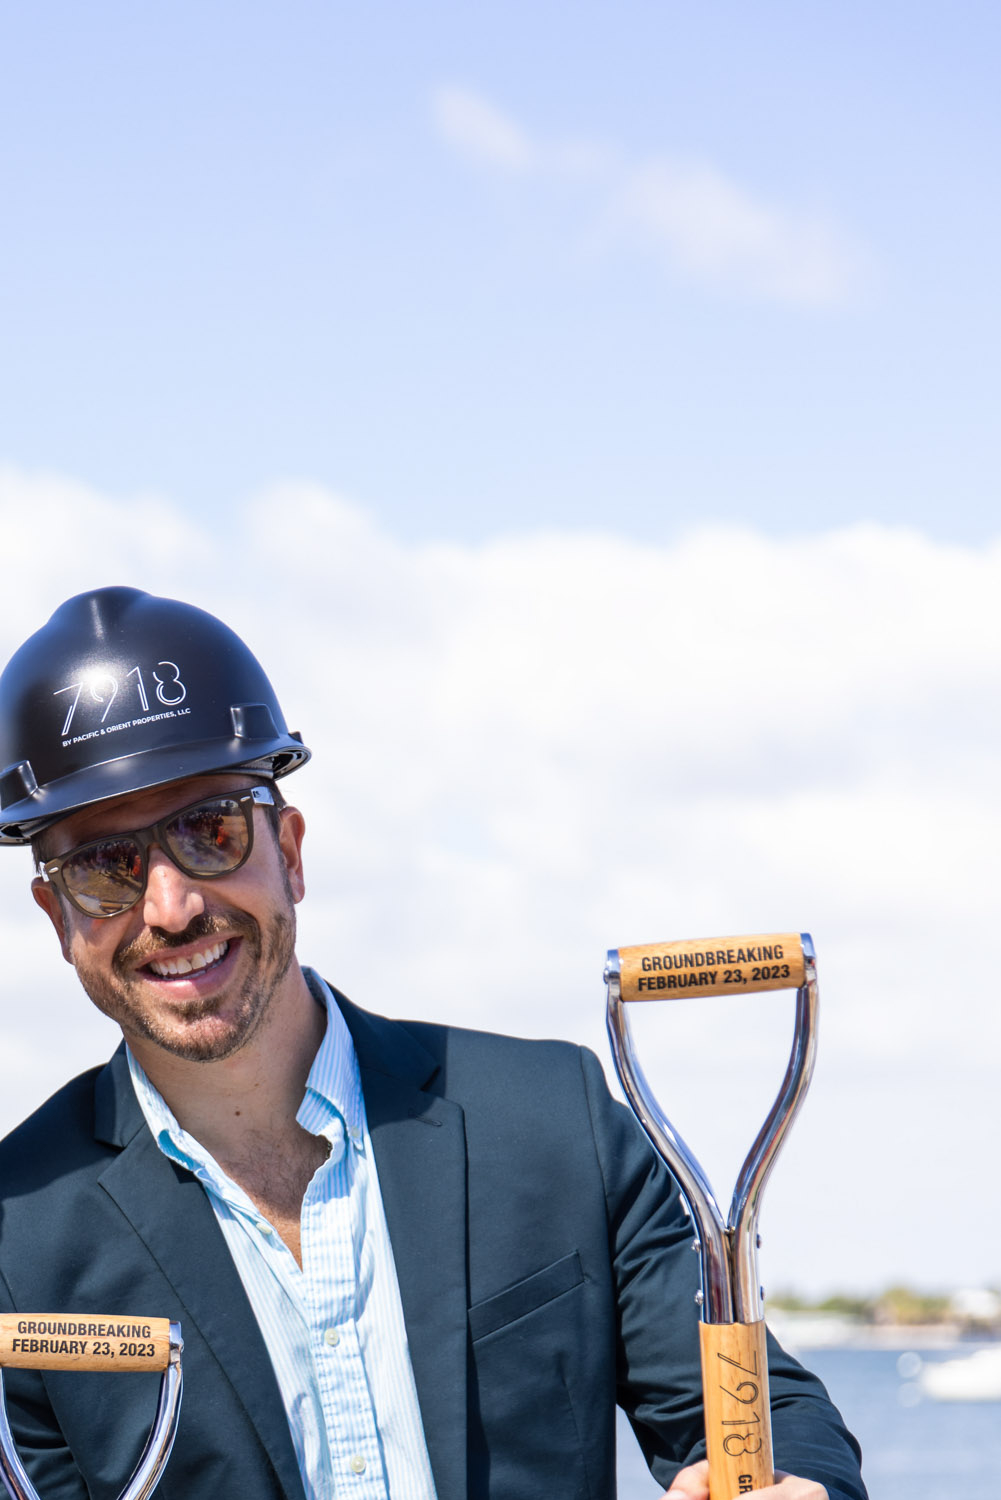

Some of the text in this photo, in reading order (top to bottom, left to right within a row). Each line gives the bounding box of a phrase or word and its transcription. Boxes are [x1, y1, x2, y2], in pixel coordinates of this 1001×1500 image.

[53, 661, 187, 736] 7918
[62, 739, 72, 748] BY
[73, 730, 100, 744] PACIFIC
[106, 721, 132, 734] ORIENT
[132, 711, 177, 726] PROPERTIES,
[177, 708, 191, 716] LLC
[641, 945, 784, 971] GROUNDBREAKING
[638, 964, 790, 991] FEBRUARY 23, 2023
[17, 1321, 151, 1339] GROUNDBREAKING
[12, 1339, 156, 1358] FEBRUARY 23, 2023
[717, 1351, 762, 1457] 7918
